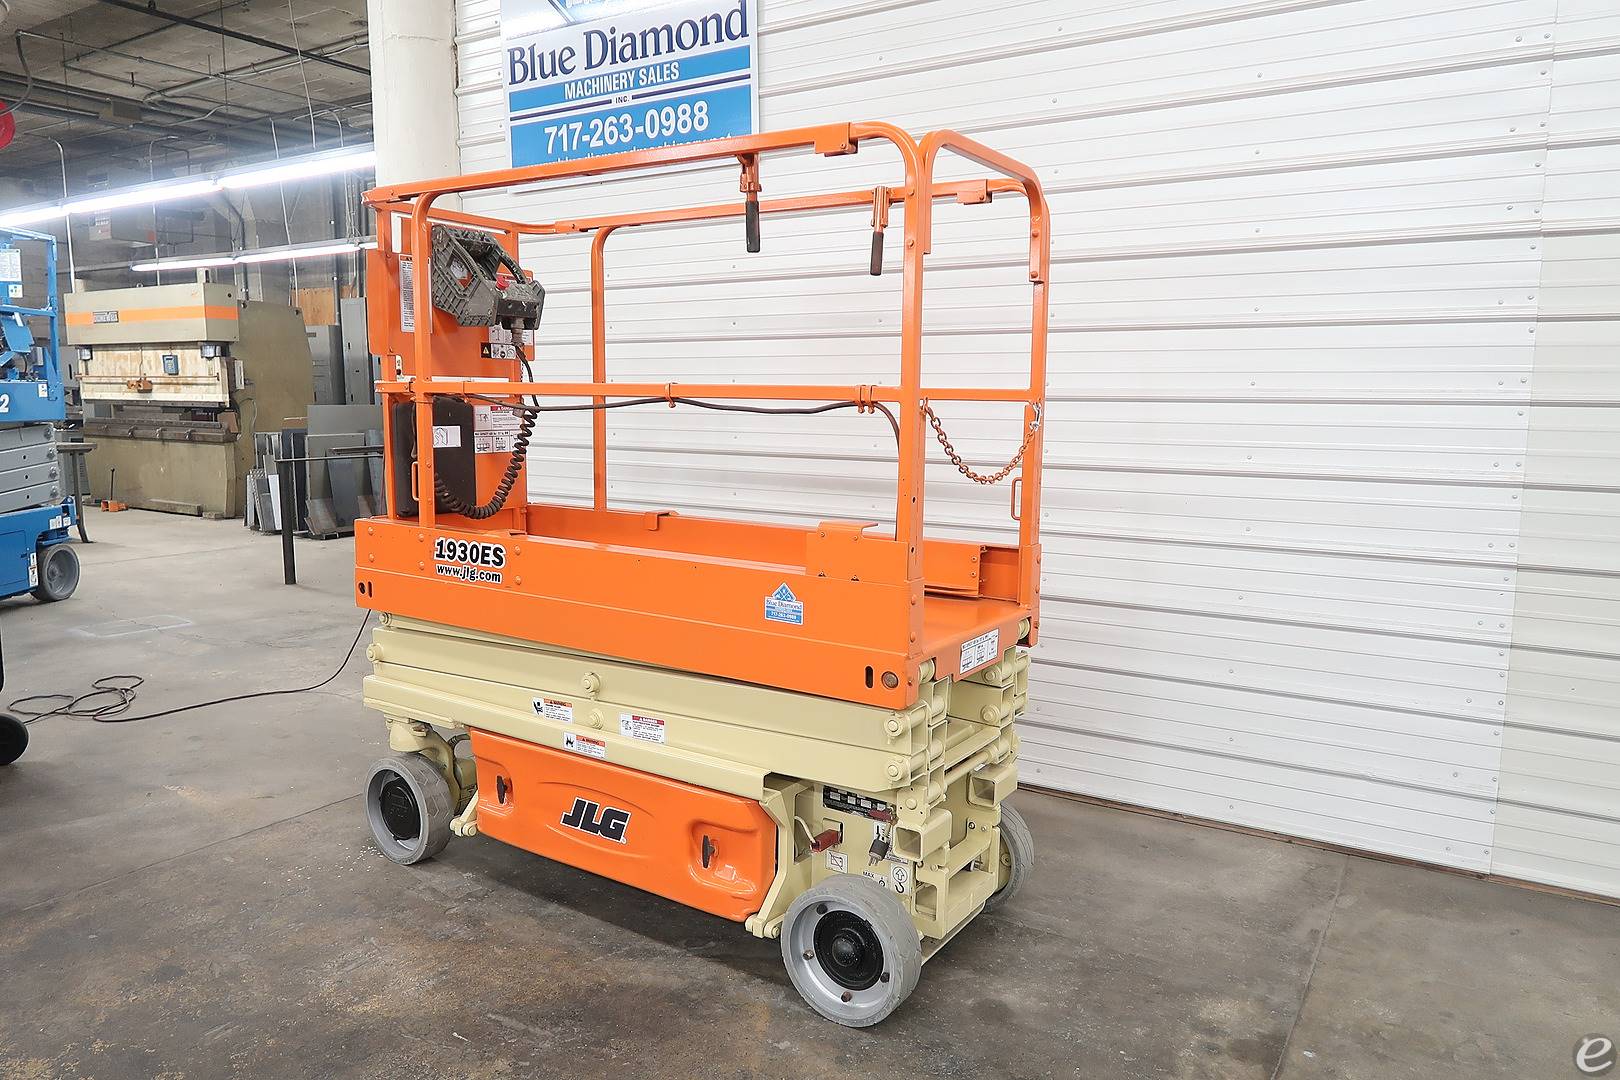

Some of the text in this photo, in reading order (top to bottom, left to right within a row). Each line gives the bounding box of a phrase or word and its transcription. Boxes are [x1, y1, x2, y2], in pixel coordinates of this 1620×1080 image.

[507, 1, 749, 85] Blue Diamond
[564, 62, 680, 100] MACHINERY SALES
[614, 96, 630, 104] INC.
[544, 100, 709, 155] 717-263-0988
[435, 540, 504, 567] 1930ES
[437, 565, 501, 583] www.jlg.com
[561, 798, 630, 842] JLG
